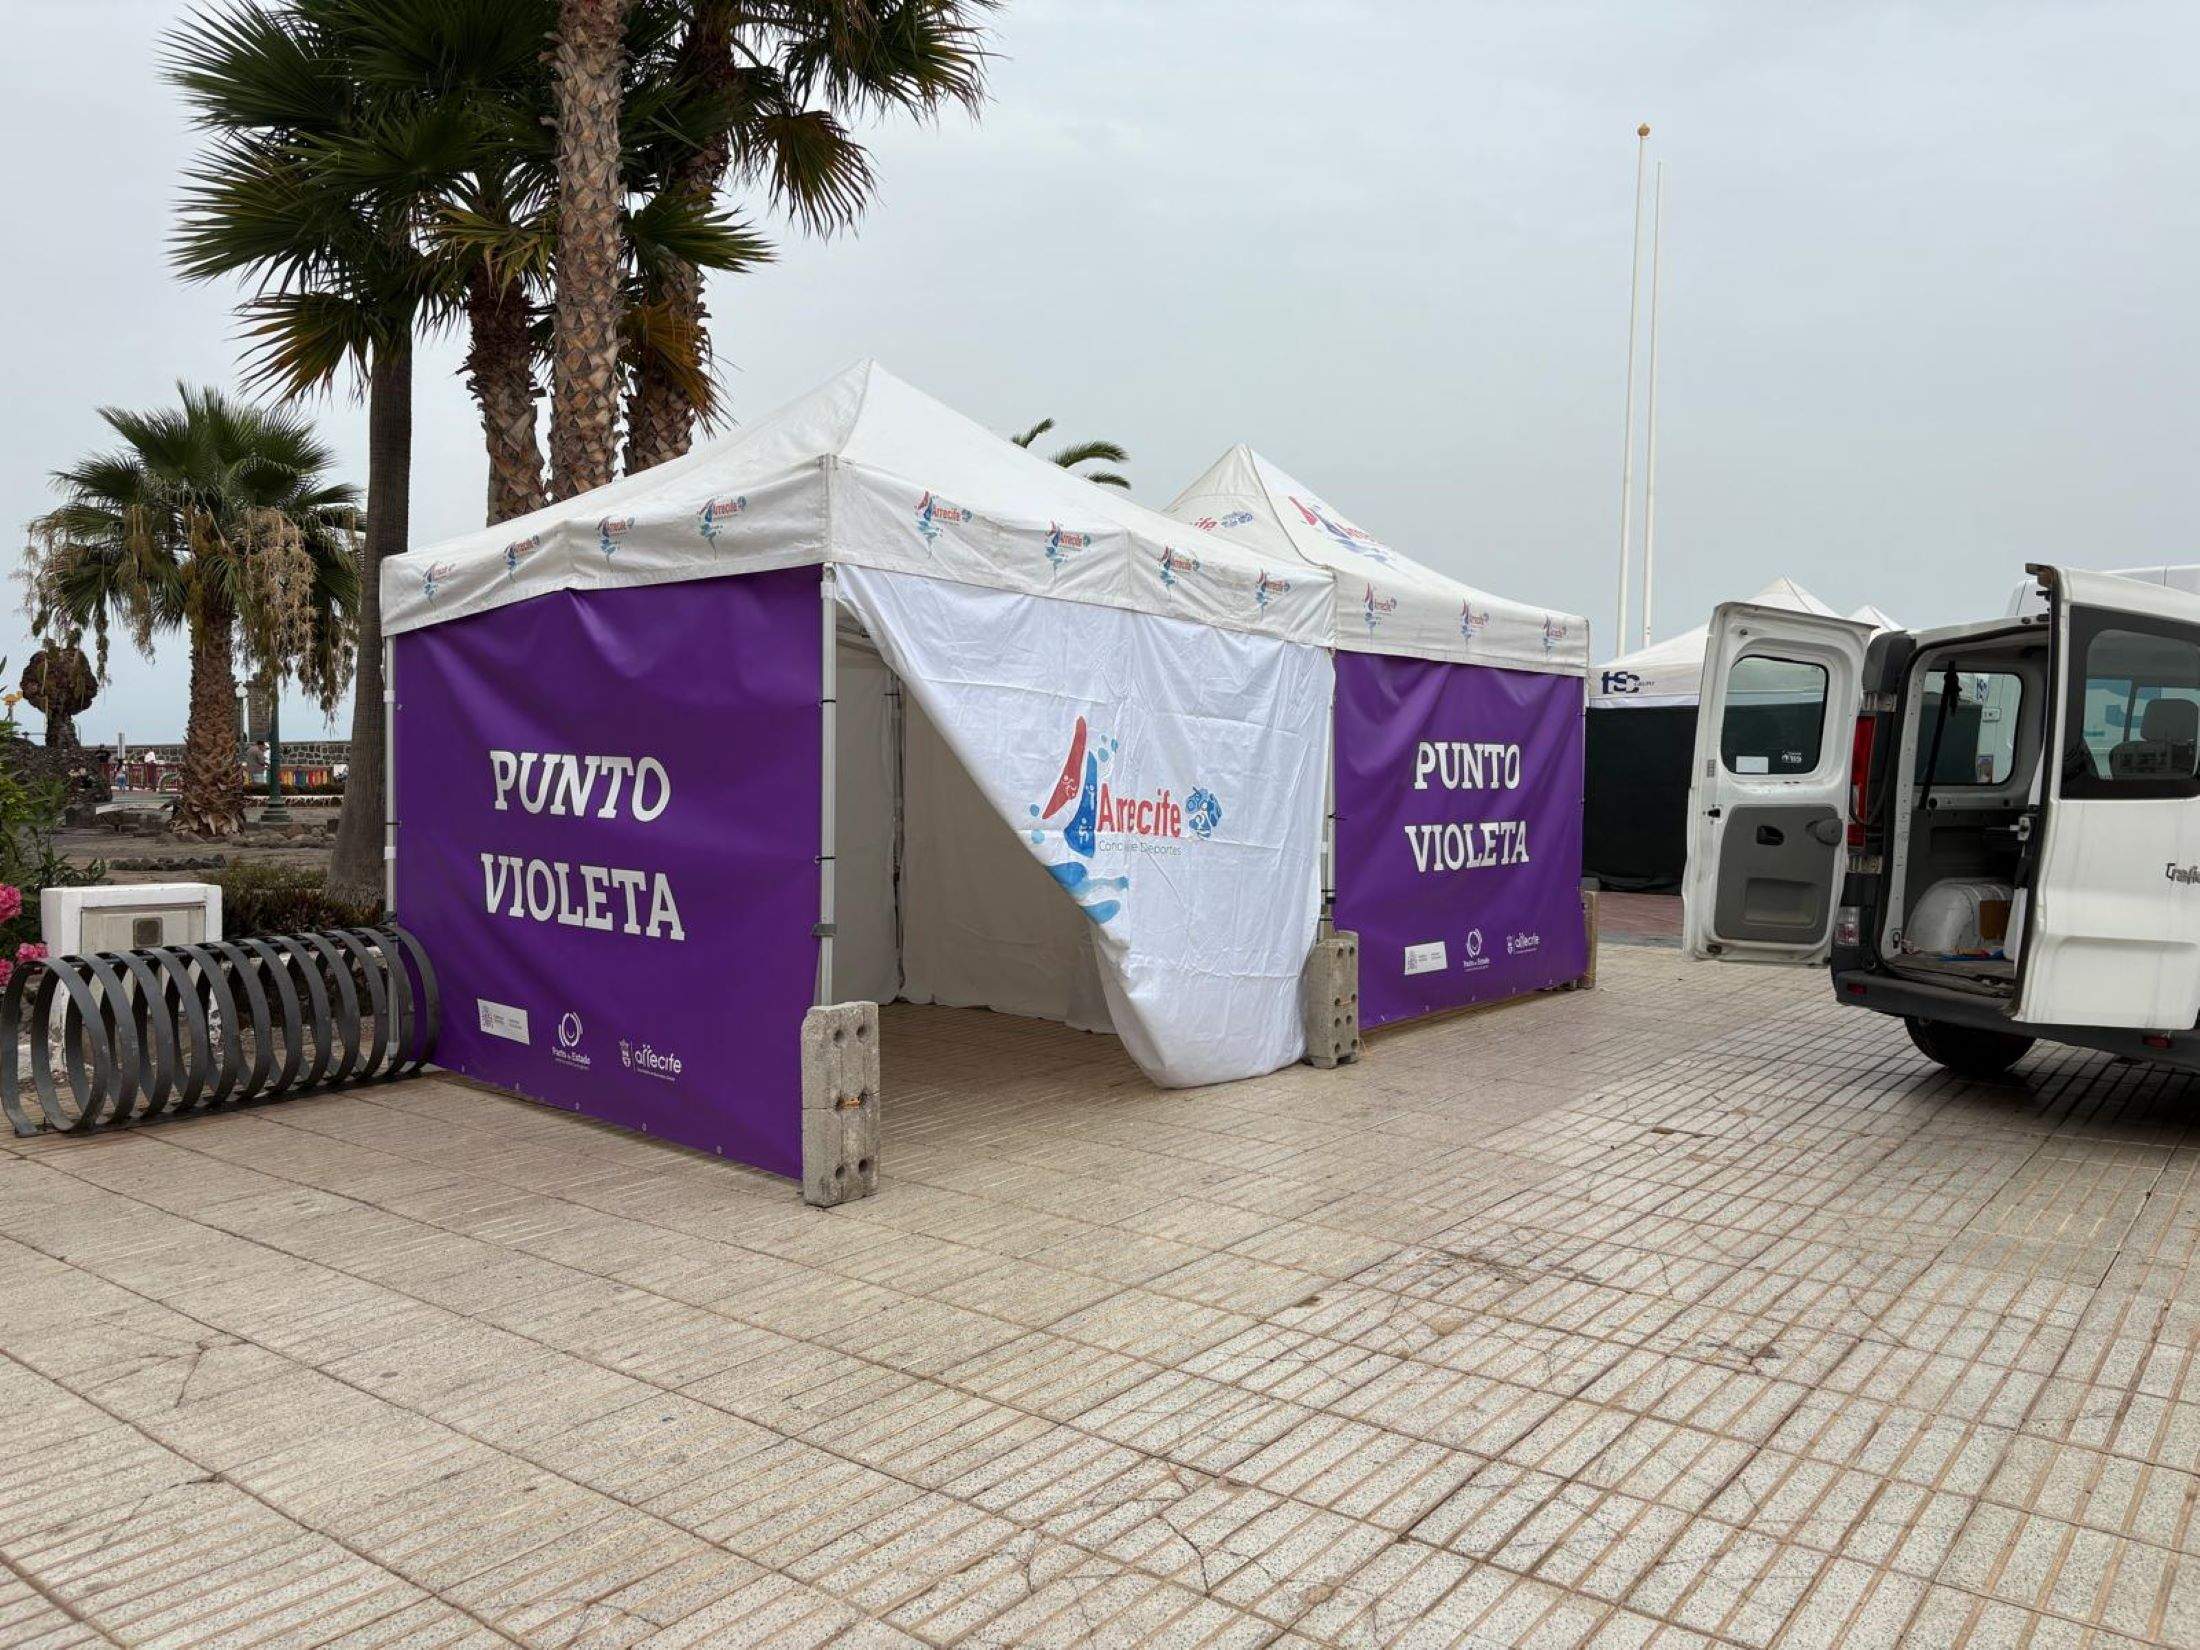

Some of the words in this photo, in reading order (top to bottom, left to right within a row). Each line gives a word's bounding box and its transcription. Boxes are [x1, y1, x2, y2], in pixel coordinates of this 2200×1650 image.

[490, 749, 671, 822] PUNTO
[1414, 742, 1520, 790] PUNTO
[1405, 821, 1529, 872] VIOLETA
[480, 853, 685, 940] VIOLETA
